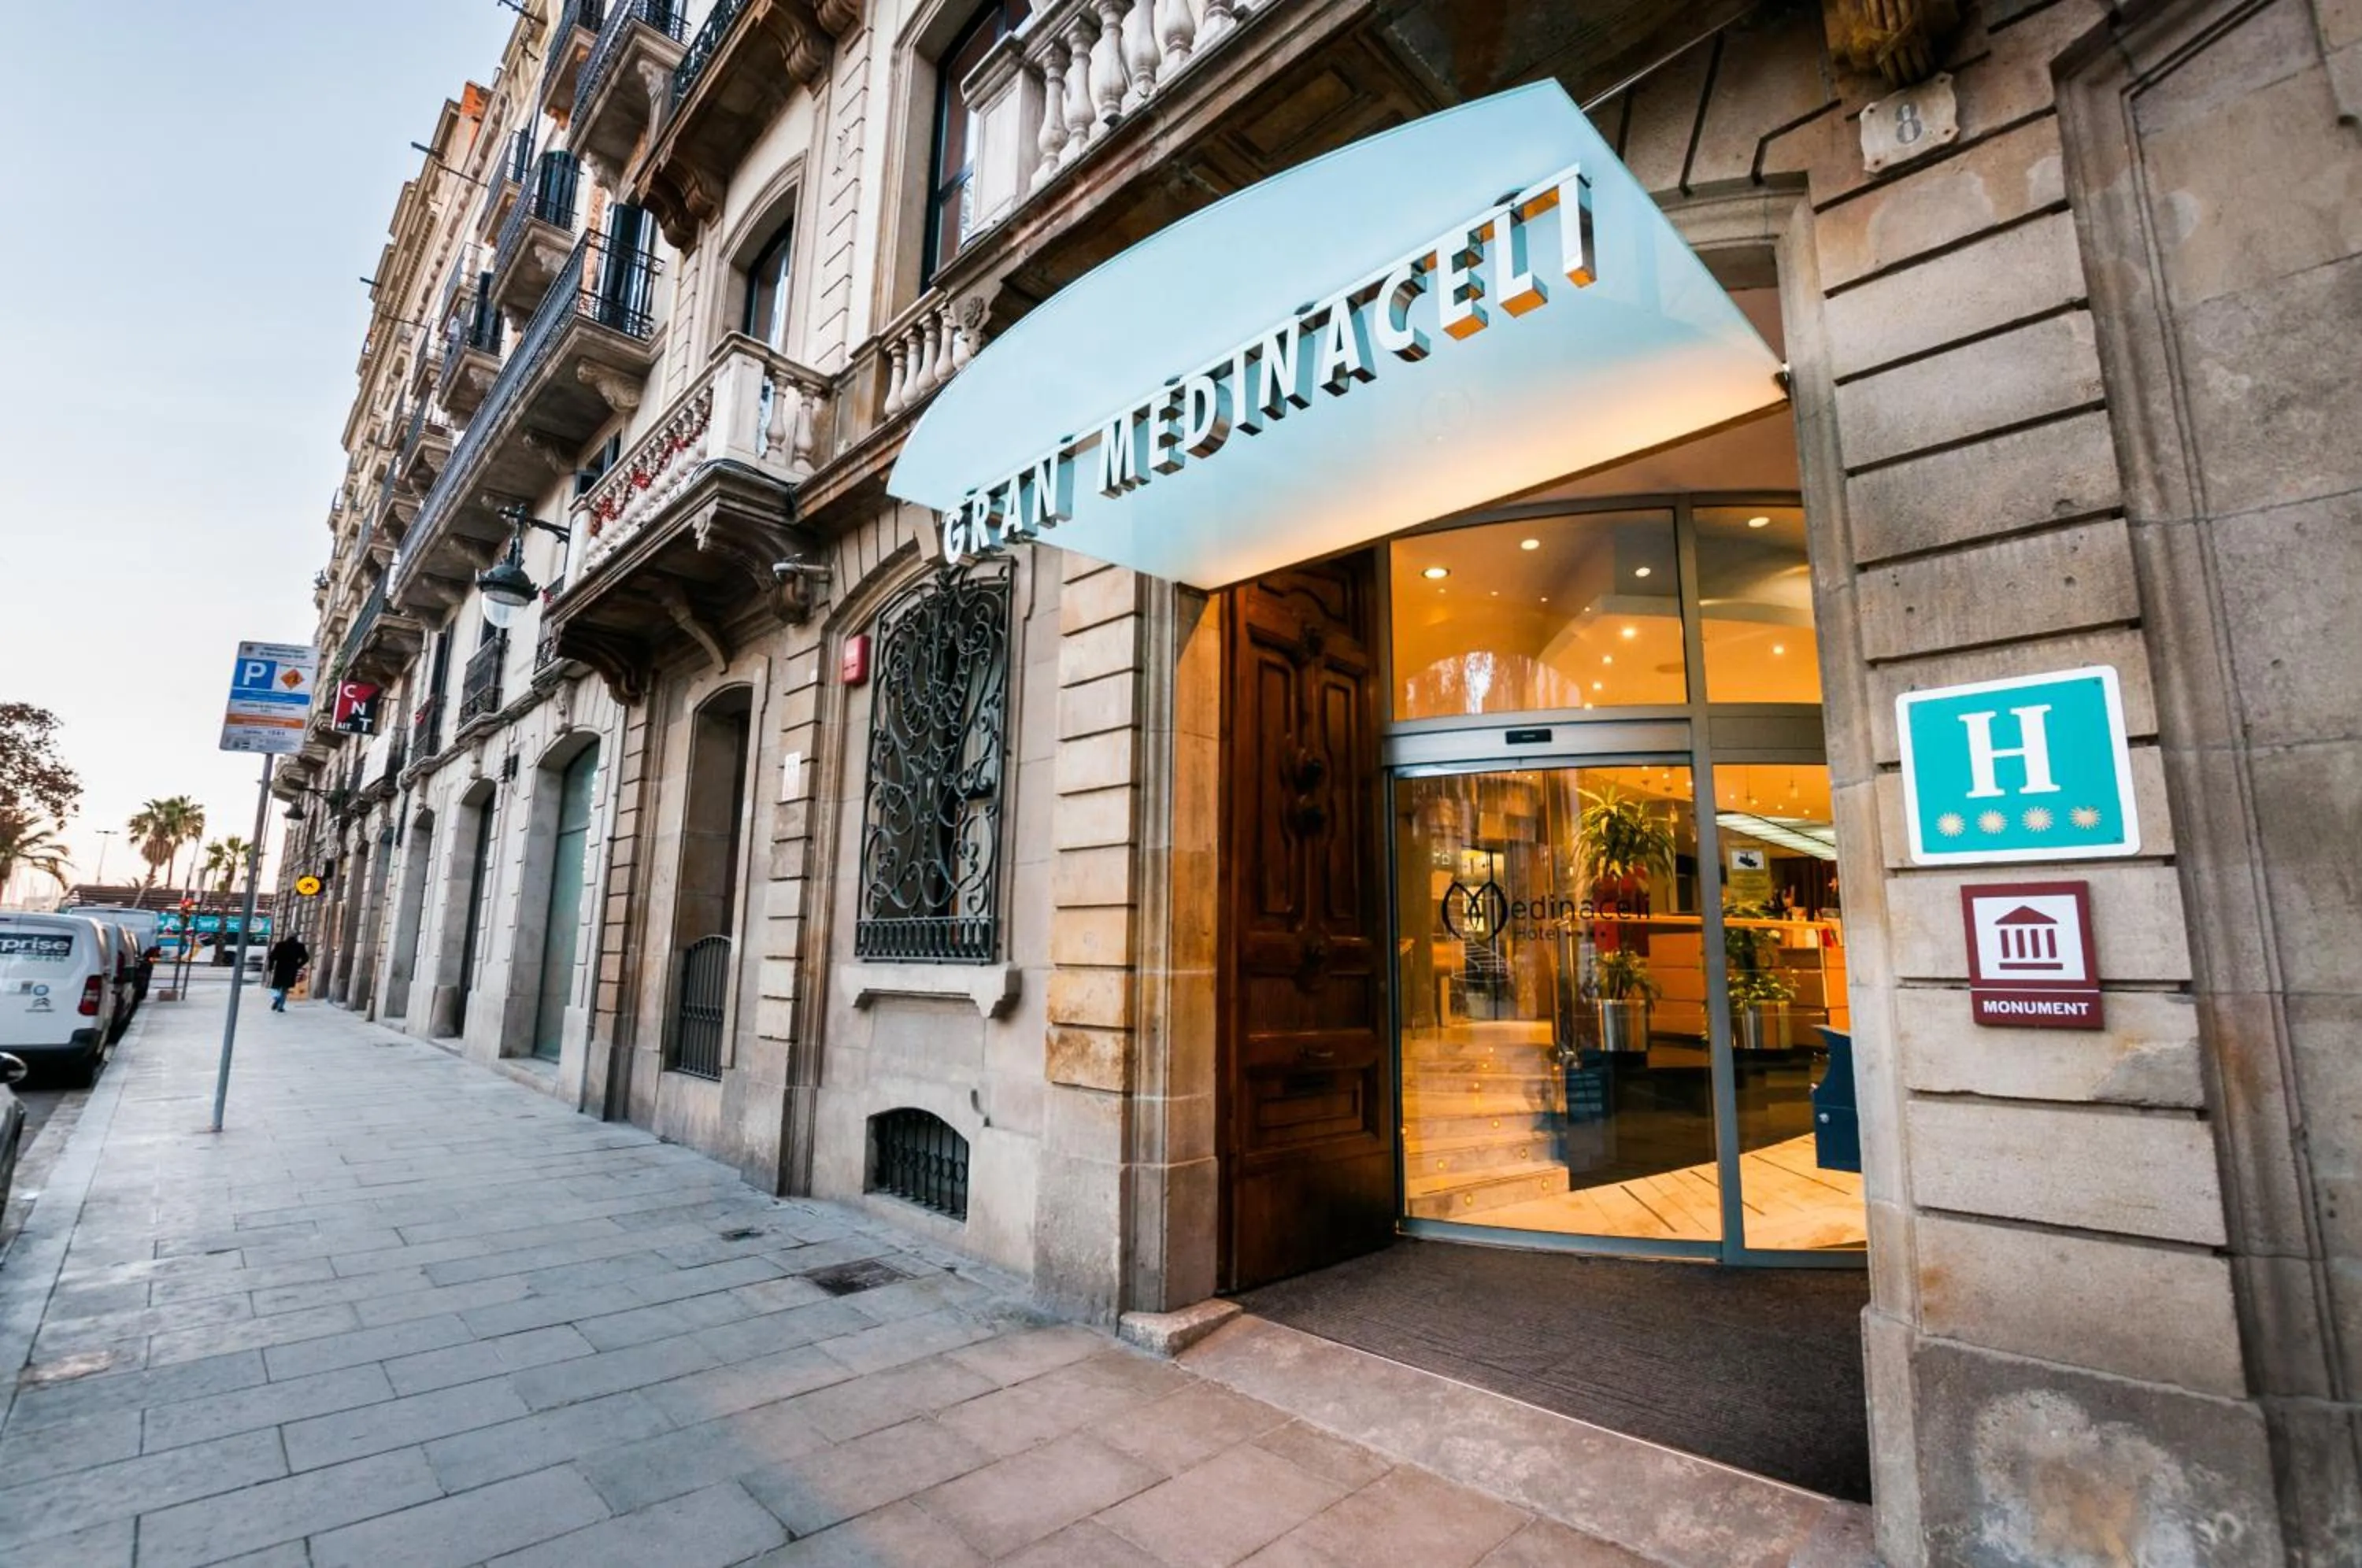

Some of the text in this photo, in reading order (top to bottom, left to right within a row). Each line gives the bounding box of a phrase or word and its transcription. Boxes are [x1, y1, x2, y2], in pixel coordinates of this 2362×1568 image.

[1895, 101, 1923, 144] 8
[943, 172, 1590, 565] GRAN MEDINACELI
[242, 662, 267, 686] P
[1958, 704, 2060, 798] H
[0, 936, 70, 951] prise
[1515, 927, 1560, 941] Hotel
[1983, 1000, 2090, 1016] MONUMENT
